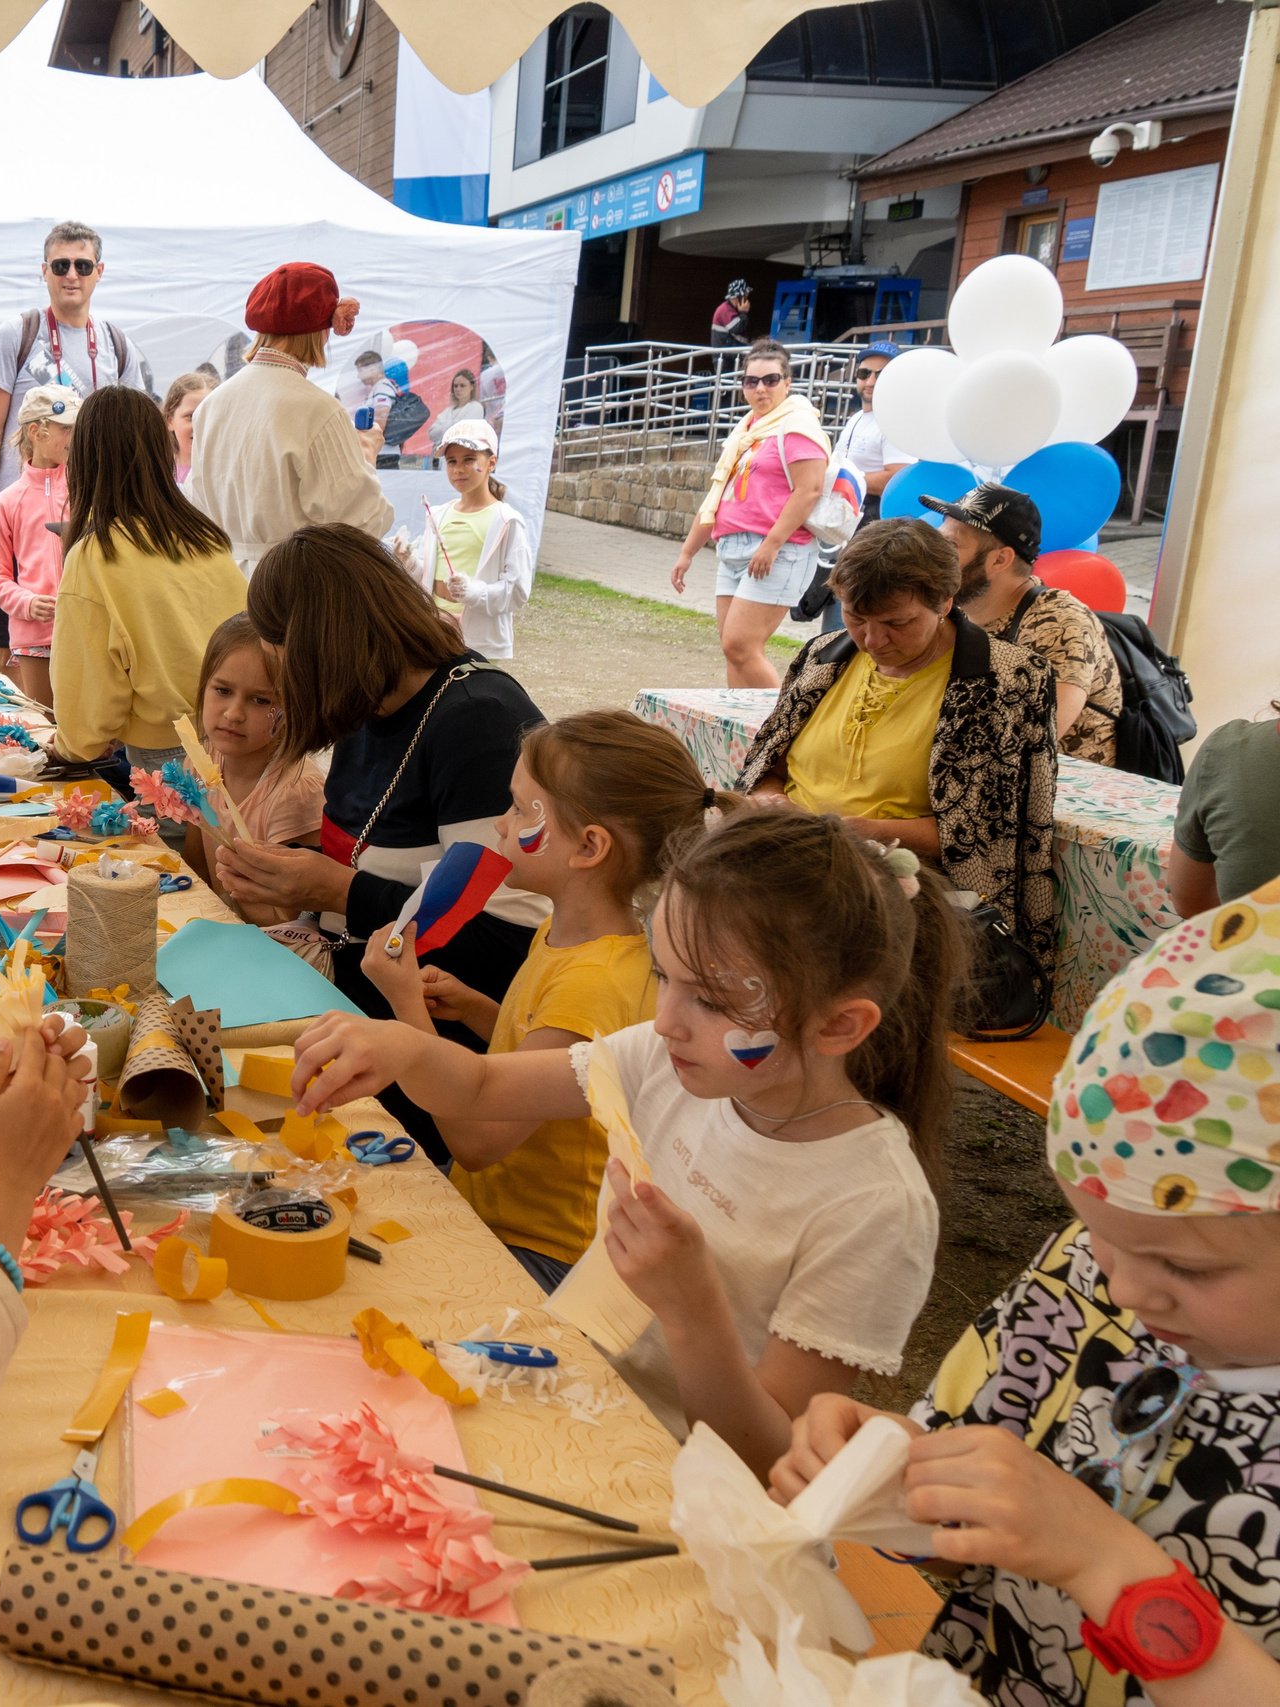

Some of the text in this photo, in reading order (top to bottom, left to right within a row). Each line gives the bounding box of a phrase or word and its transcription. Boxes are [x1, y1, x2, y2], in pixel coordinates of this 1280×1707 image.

[872, 343, 898, 355] OBEY
[284, 929, 311, 943] GIRL
[672, 1137, 693, 1167] CUTE
[686, 1169, 738, 1221] SPECIAL
[278, 1213, 305, 1224] UNIBOB
